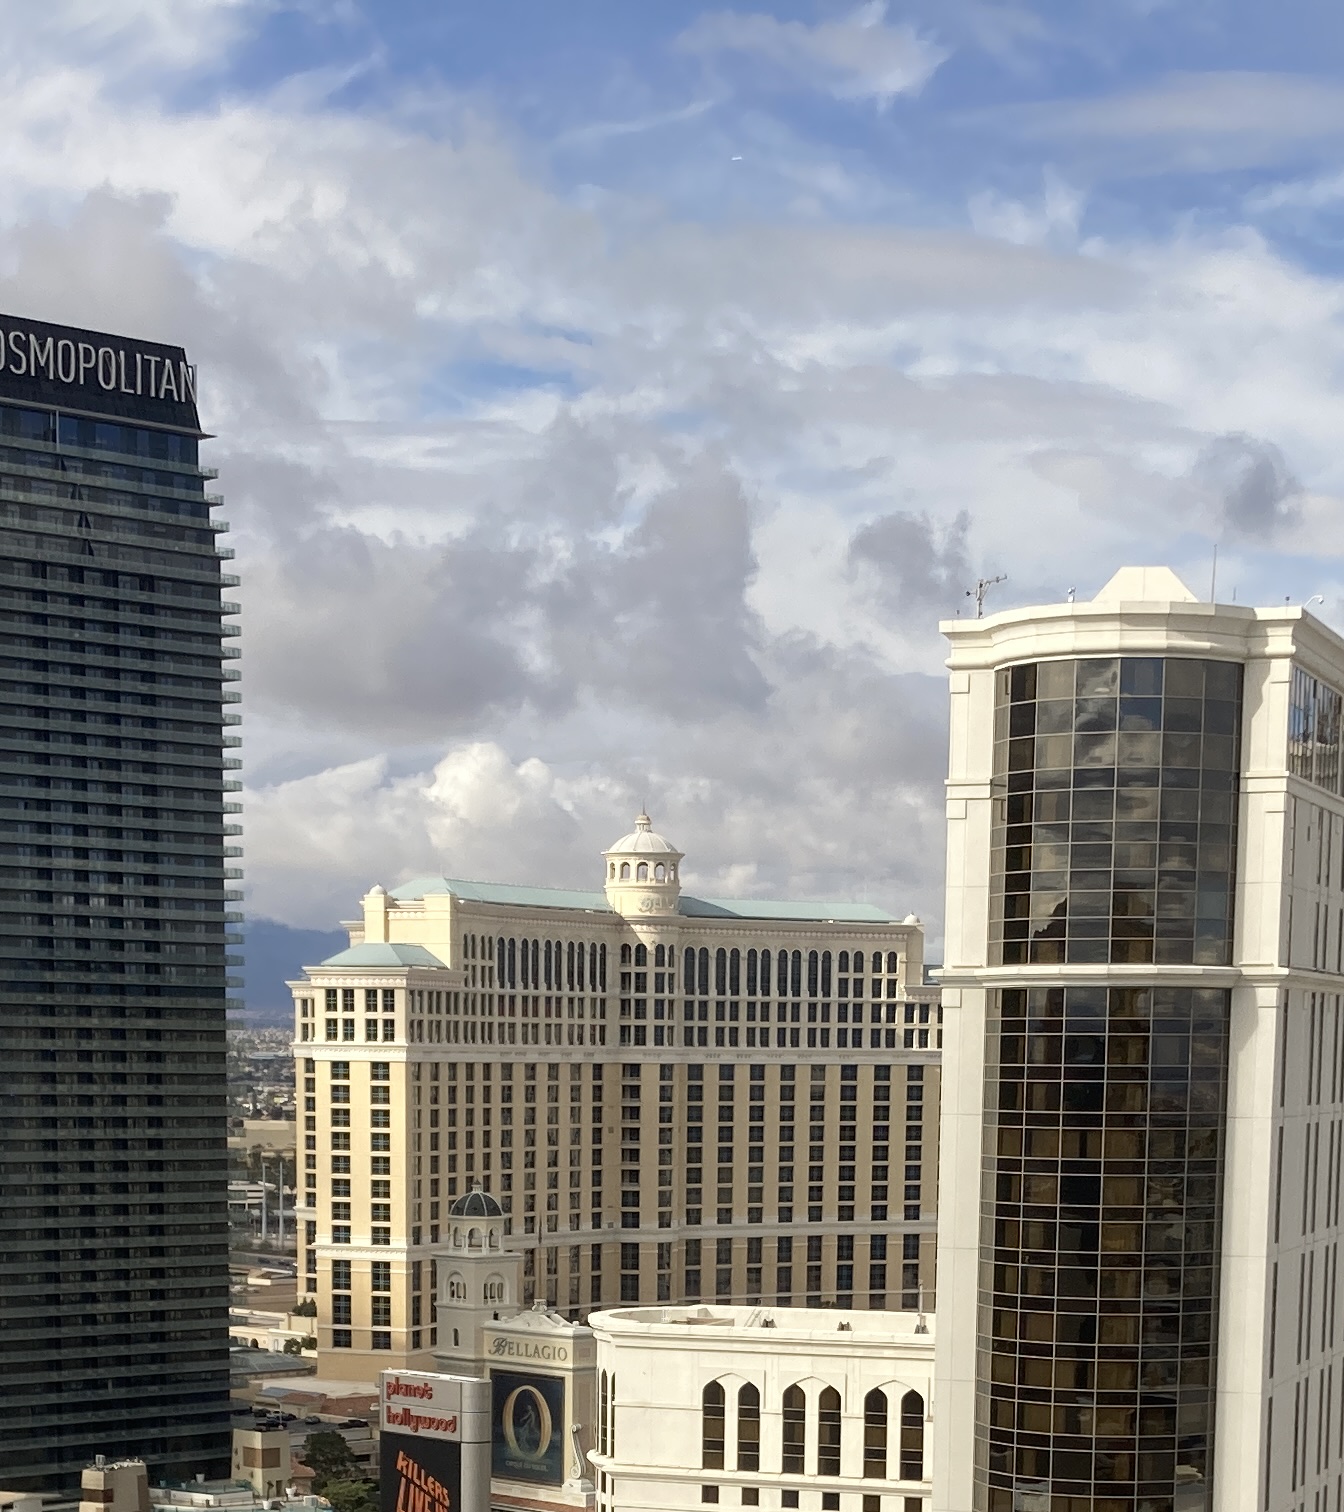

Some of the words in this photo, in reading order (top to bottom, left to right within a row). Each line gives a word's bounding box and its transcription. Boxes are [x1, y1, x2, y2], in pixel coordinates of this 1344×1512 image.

[488, 1338, 568, 1361] BELLAGIO
[386, 1376, 433, 1400] planet
[386, 1405, 457, 1433] hollywood
[502, 1385, 552, 1460] O
[396, 1450, 450, 1507] KILLERS
